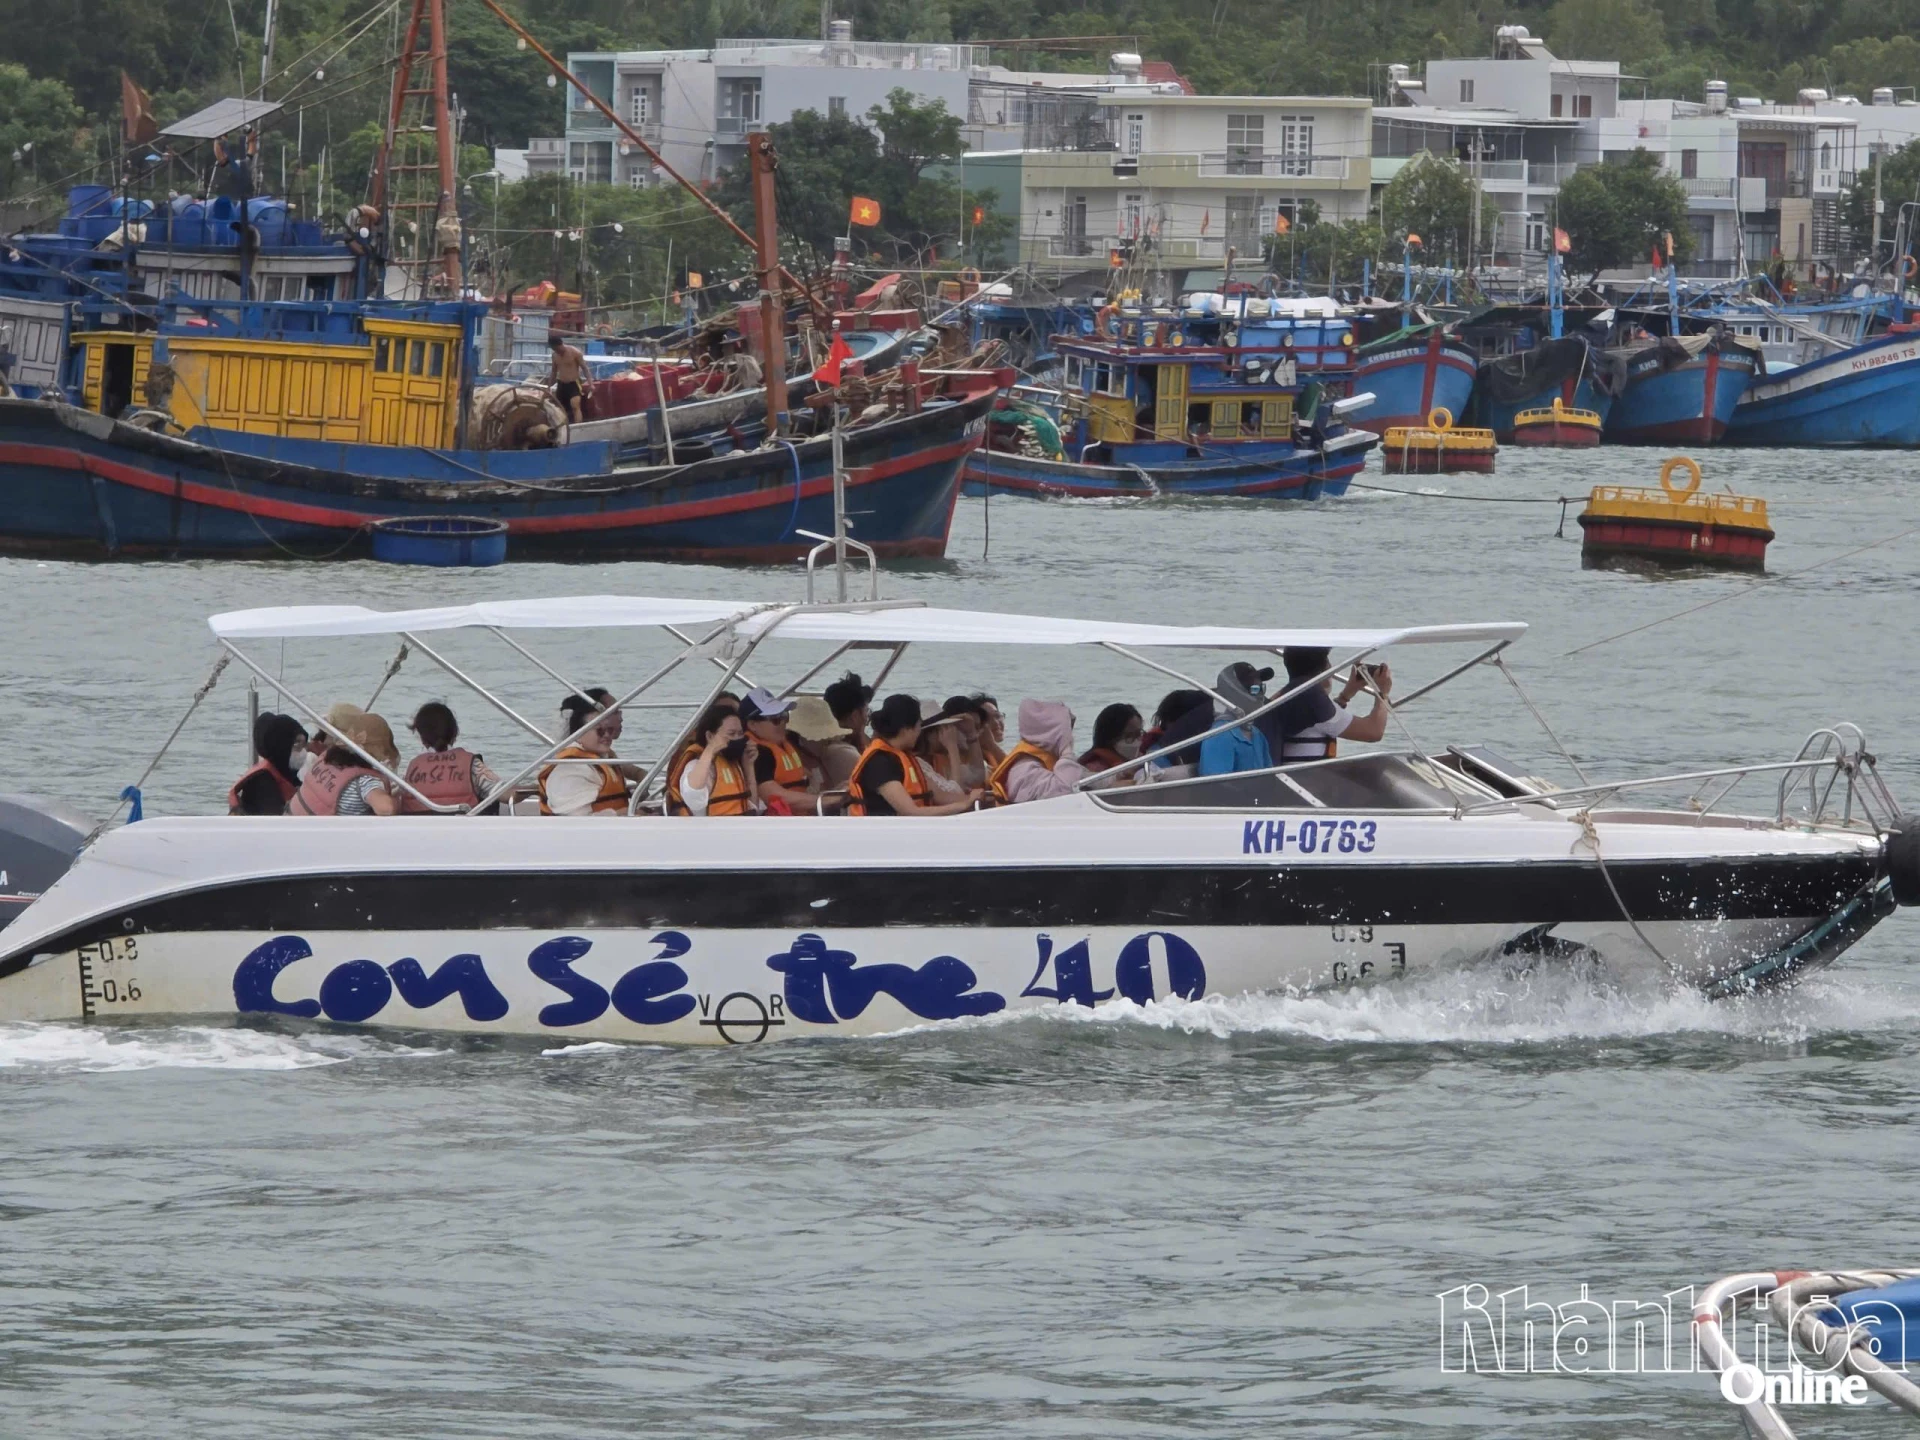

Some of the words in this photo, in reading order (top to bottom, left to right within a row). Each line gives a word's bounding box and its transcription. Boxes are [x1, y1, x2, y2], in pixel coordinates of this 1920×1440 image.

[1852, 361, 1867, 370] KH
[1901, 347, 1916, 358] TS
[1243, 820, 1377, 854] KH-0763
[100, 938, 138, 962] 0.8
[1020, 931, 1207, 1008] 40
[103, 978, 141, 1002] 0.6
